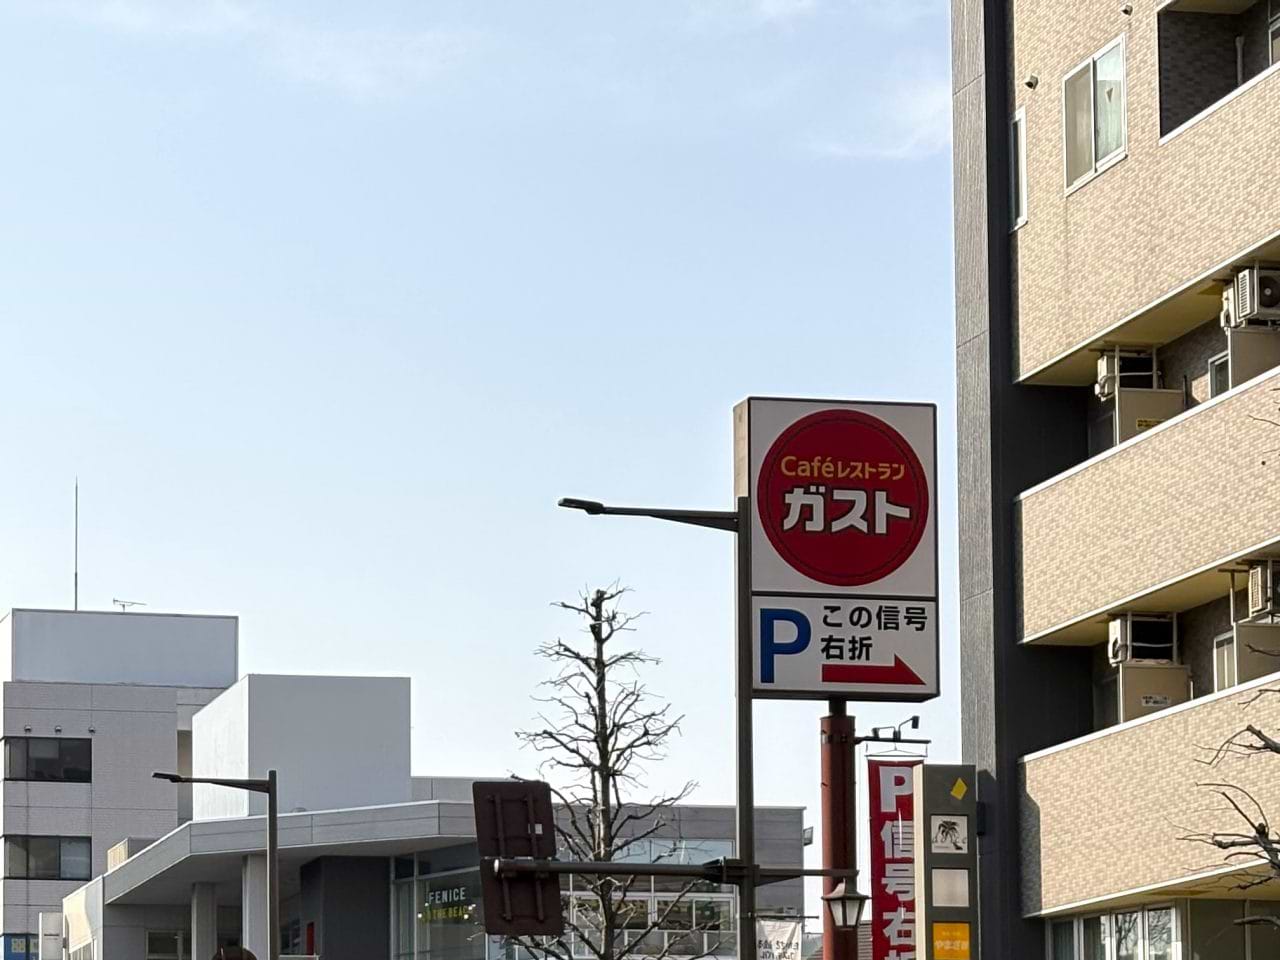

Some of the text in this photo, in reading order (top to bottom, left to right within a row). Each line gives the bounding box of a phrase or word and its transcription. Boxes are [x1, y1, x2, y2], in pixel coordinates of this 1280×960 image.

[780, 456, 905, 481] Caféレストラン
[782, 485, 911, 534] ガスト
[823, 604, 928, 632] この信号
[760, 608, 811, 684] P
[820, 635, 873, 662] 右折
[429, 887, 467, 904] FENICE
